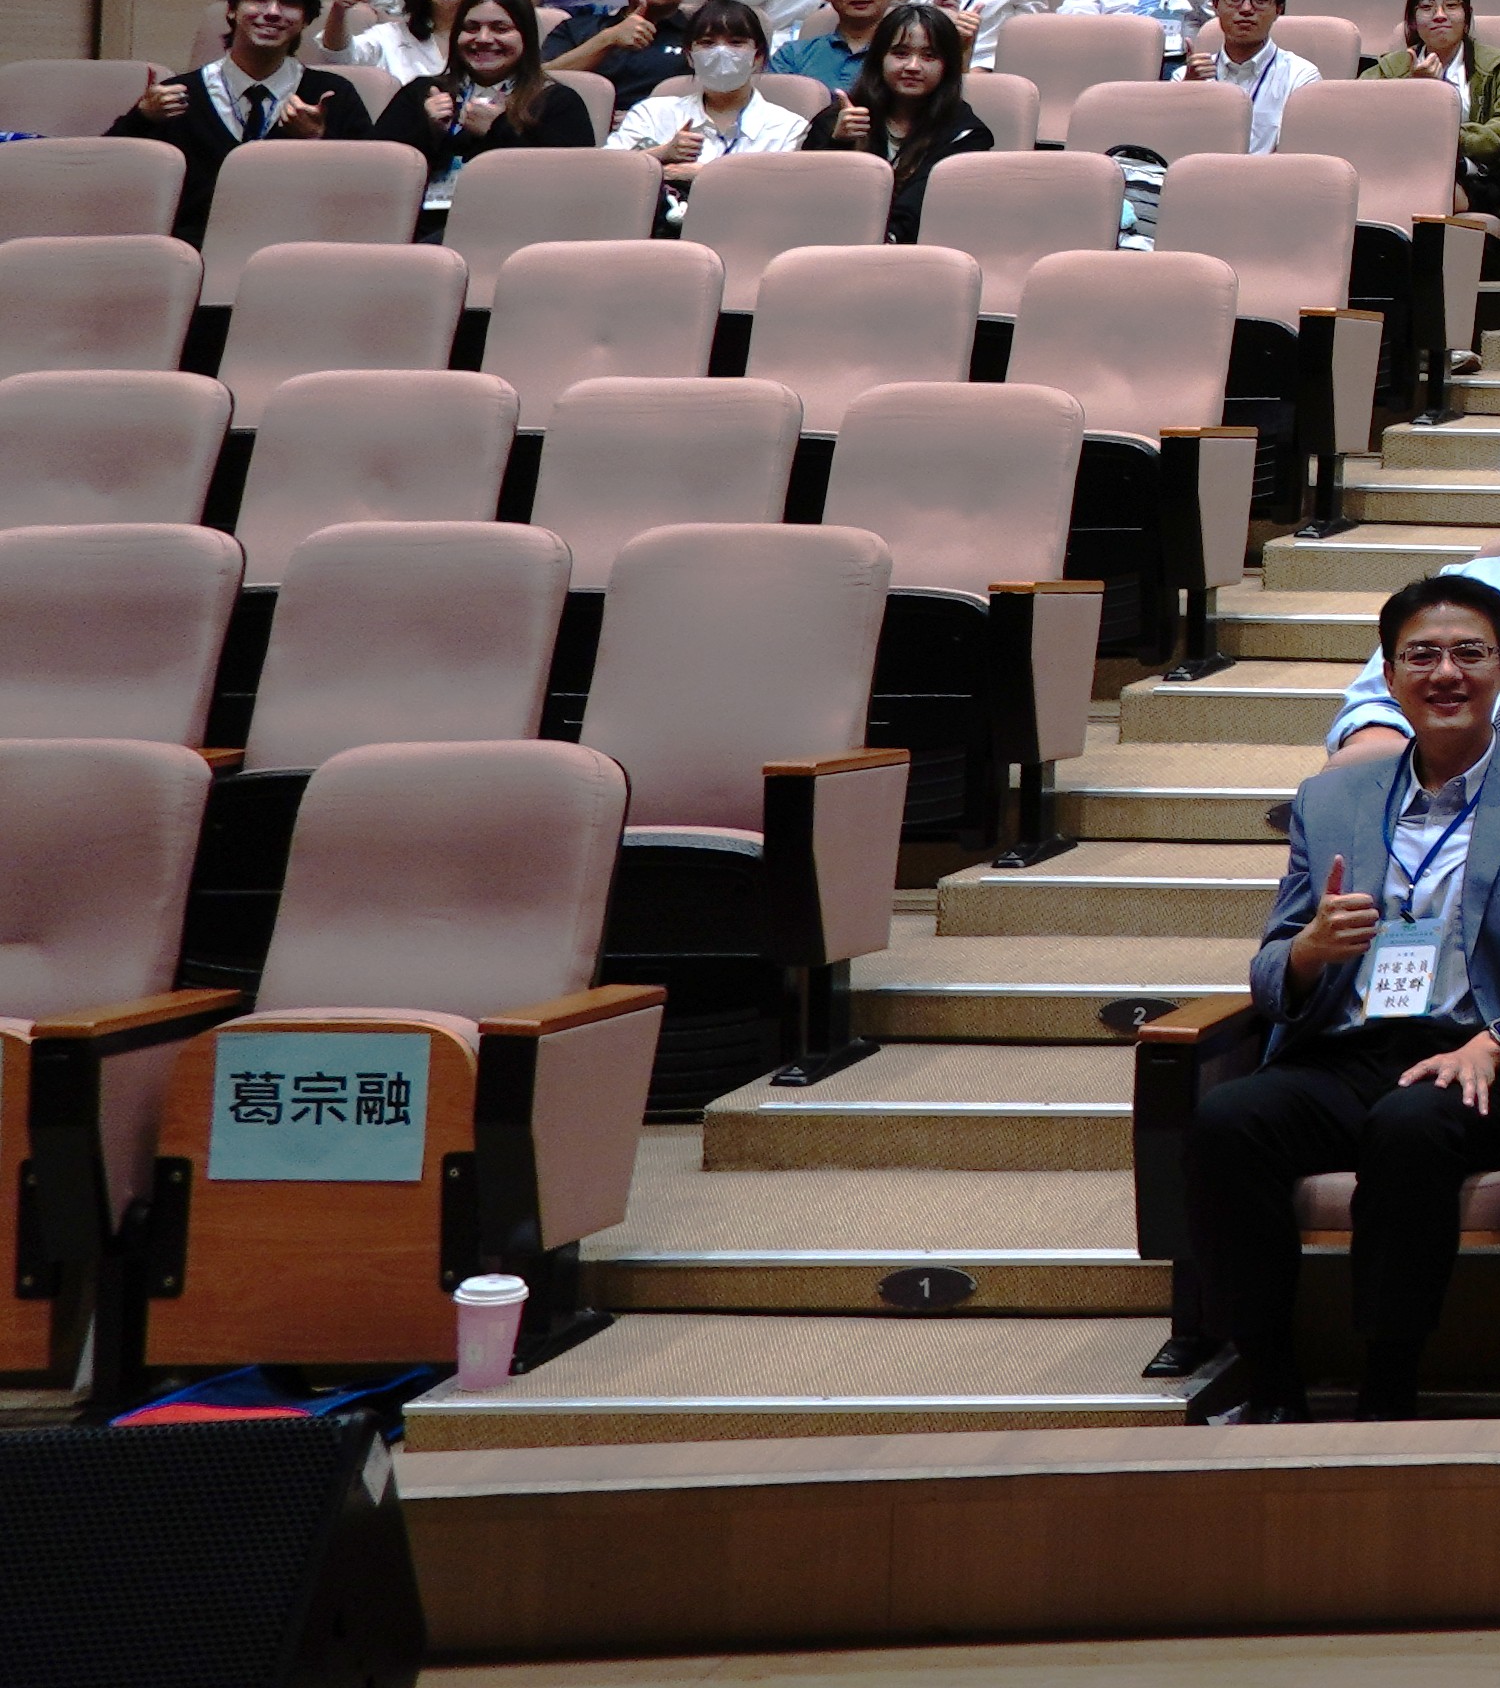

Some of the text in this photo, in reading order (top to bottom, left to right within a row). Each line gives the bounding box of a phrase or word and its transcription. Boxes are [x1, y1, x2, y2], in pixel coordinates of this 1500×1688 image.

[1133, 1006, 1147, 1025] 2
[229, 1071, 412, 1126] 葛宗融
[918, 1277, 930, 1298] 1
